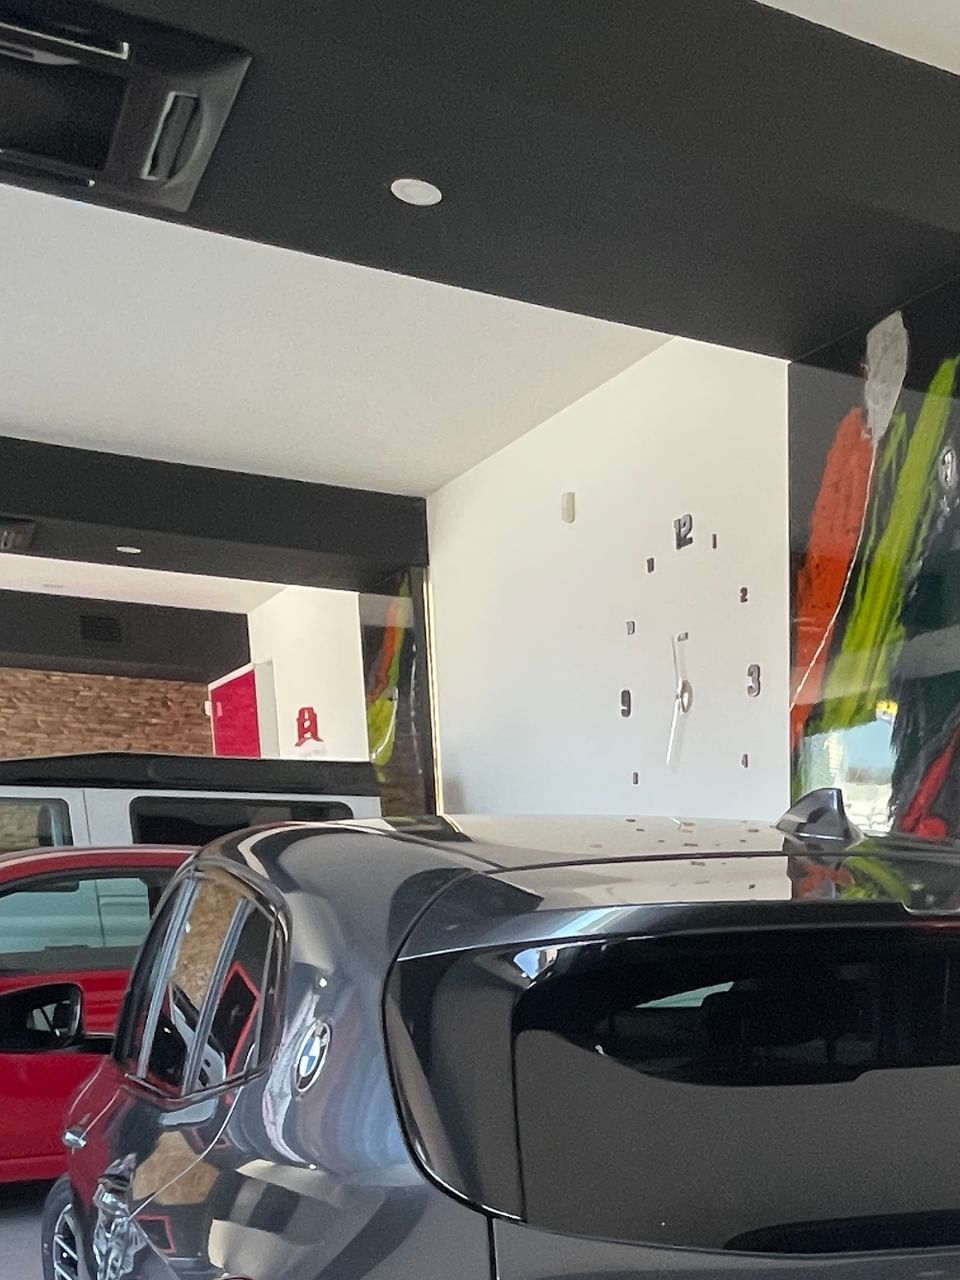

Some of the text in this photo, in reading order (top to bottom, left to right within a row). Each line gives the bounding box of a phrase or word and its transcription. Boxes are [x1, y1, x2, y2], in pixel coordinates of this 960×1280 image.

[674, 514, 693, 550] 12
[748, 664, 761, 697] 3
[620, 689, 632, 717] 9
